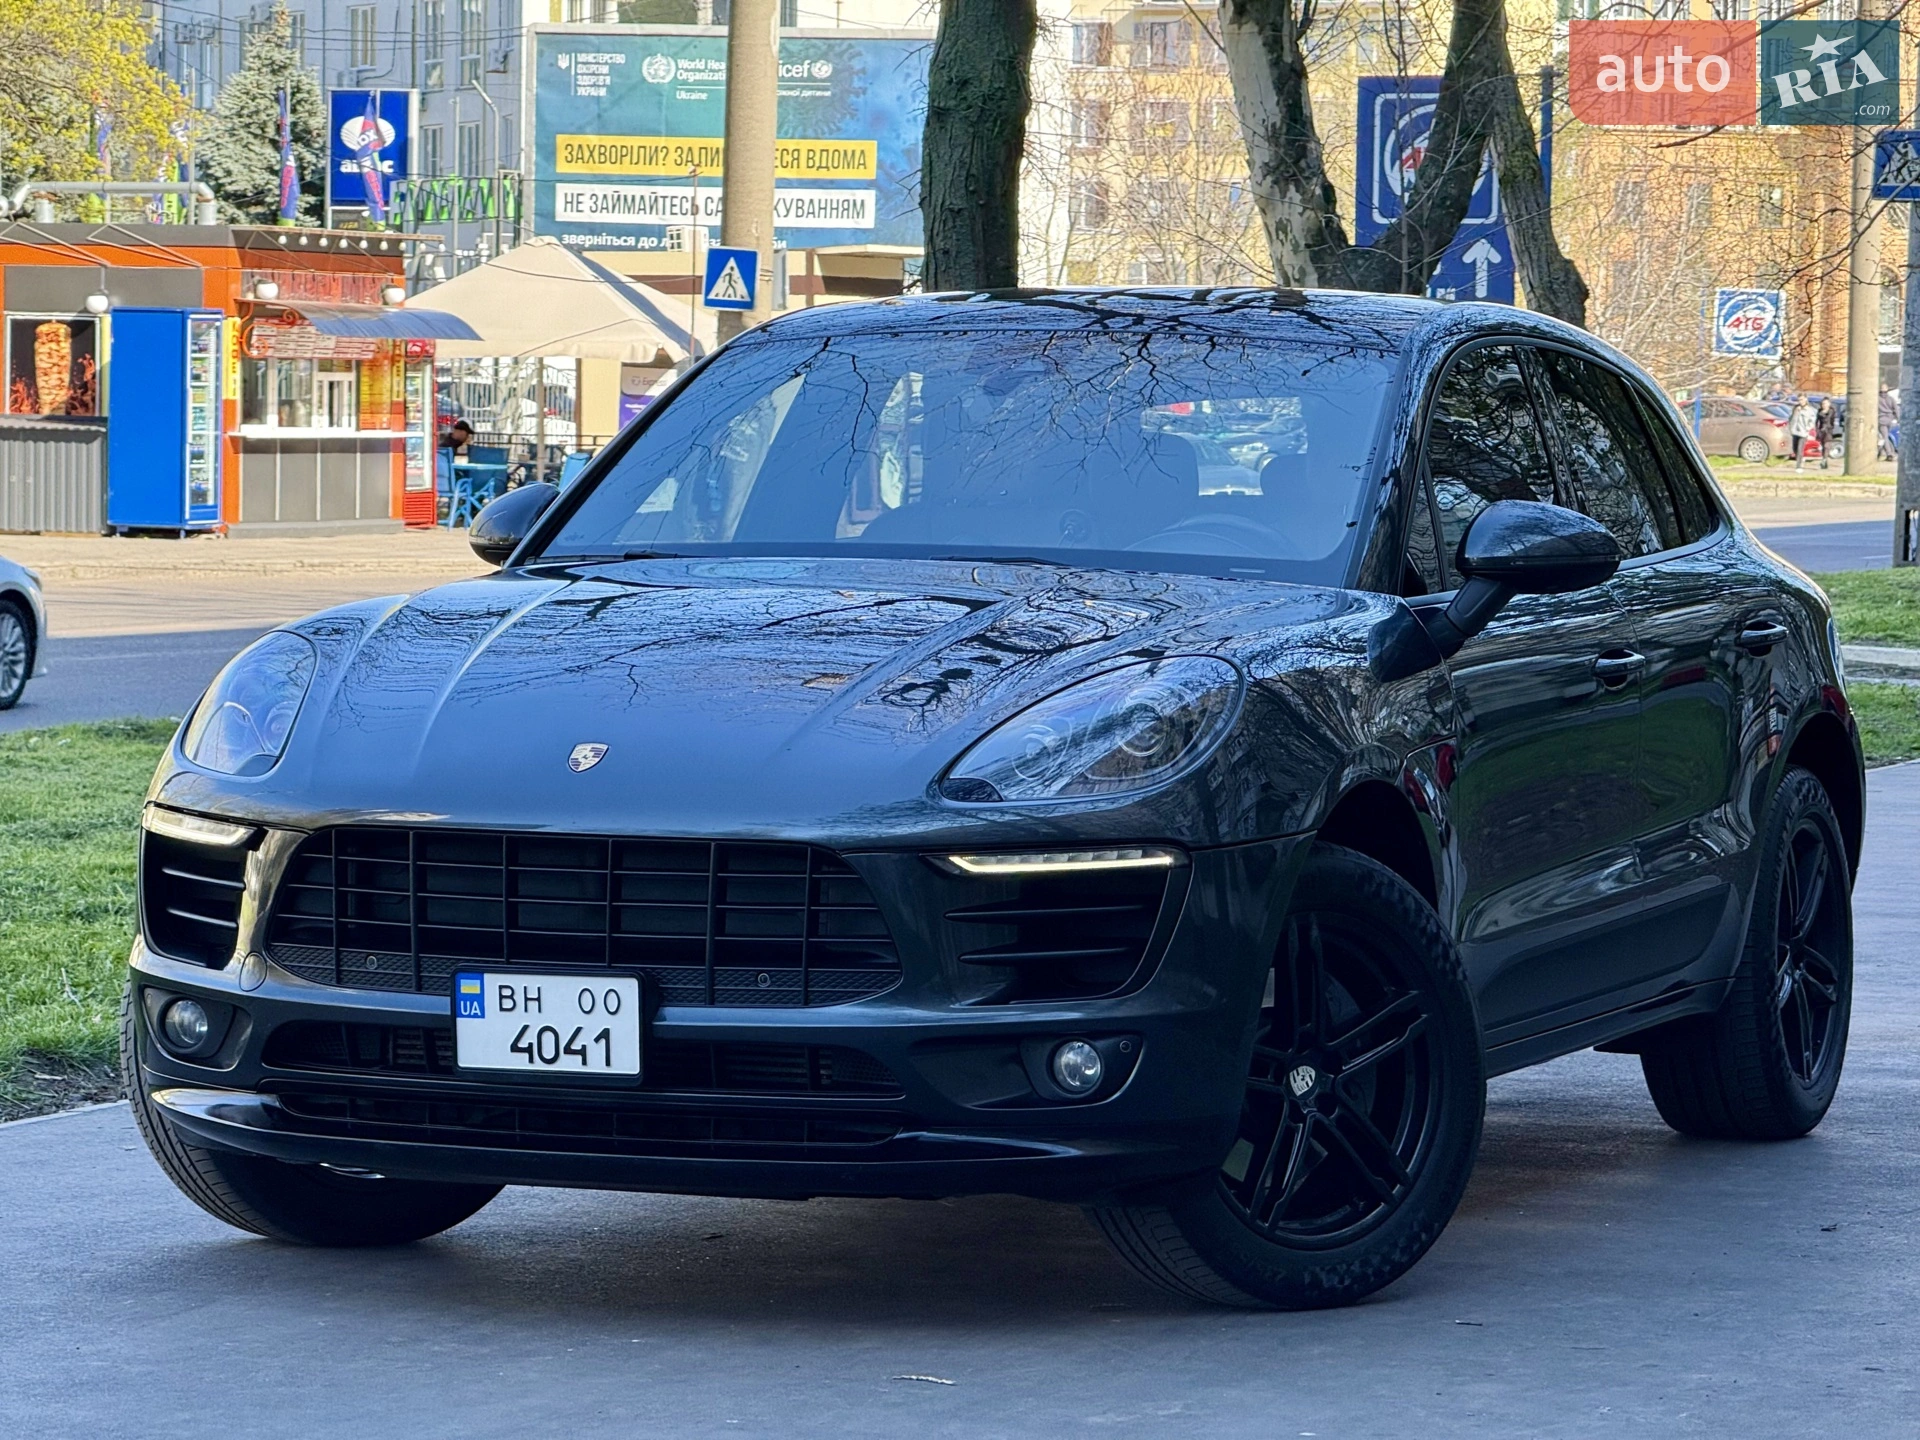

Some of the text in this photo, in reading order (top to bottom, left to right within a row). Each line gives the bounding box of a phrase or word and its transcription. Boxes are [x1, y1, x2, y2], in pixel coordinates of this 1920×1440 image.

[677, 59, 726, 70] World Hea
[778, 60, 811, 78] icef
[676, 69, 727, 82] Organizati
[676, 90, 708, 100] Ukraine
[564, 143, 669, 167] ЗАХВОРІЛИ?
[806, 148, 867, 171] ВДОМА
[564, 192, 585, 213] НЕ
[589, 190, 699, 216] ЗАЙМАЙТЕСЬ
[561, 233, 636, 247] зверніться
[637, 237, 659, 248] до
[498, 984, 542, 1013] BH
[460, 1001, 481, 1016] UA
[510, 1024, 611, 1067] 4041
